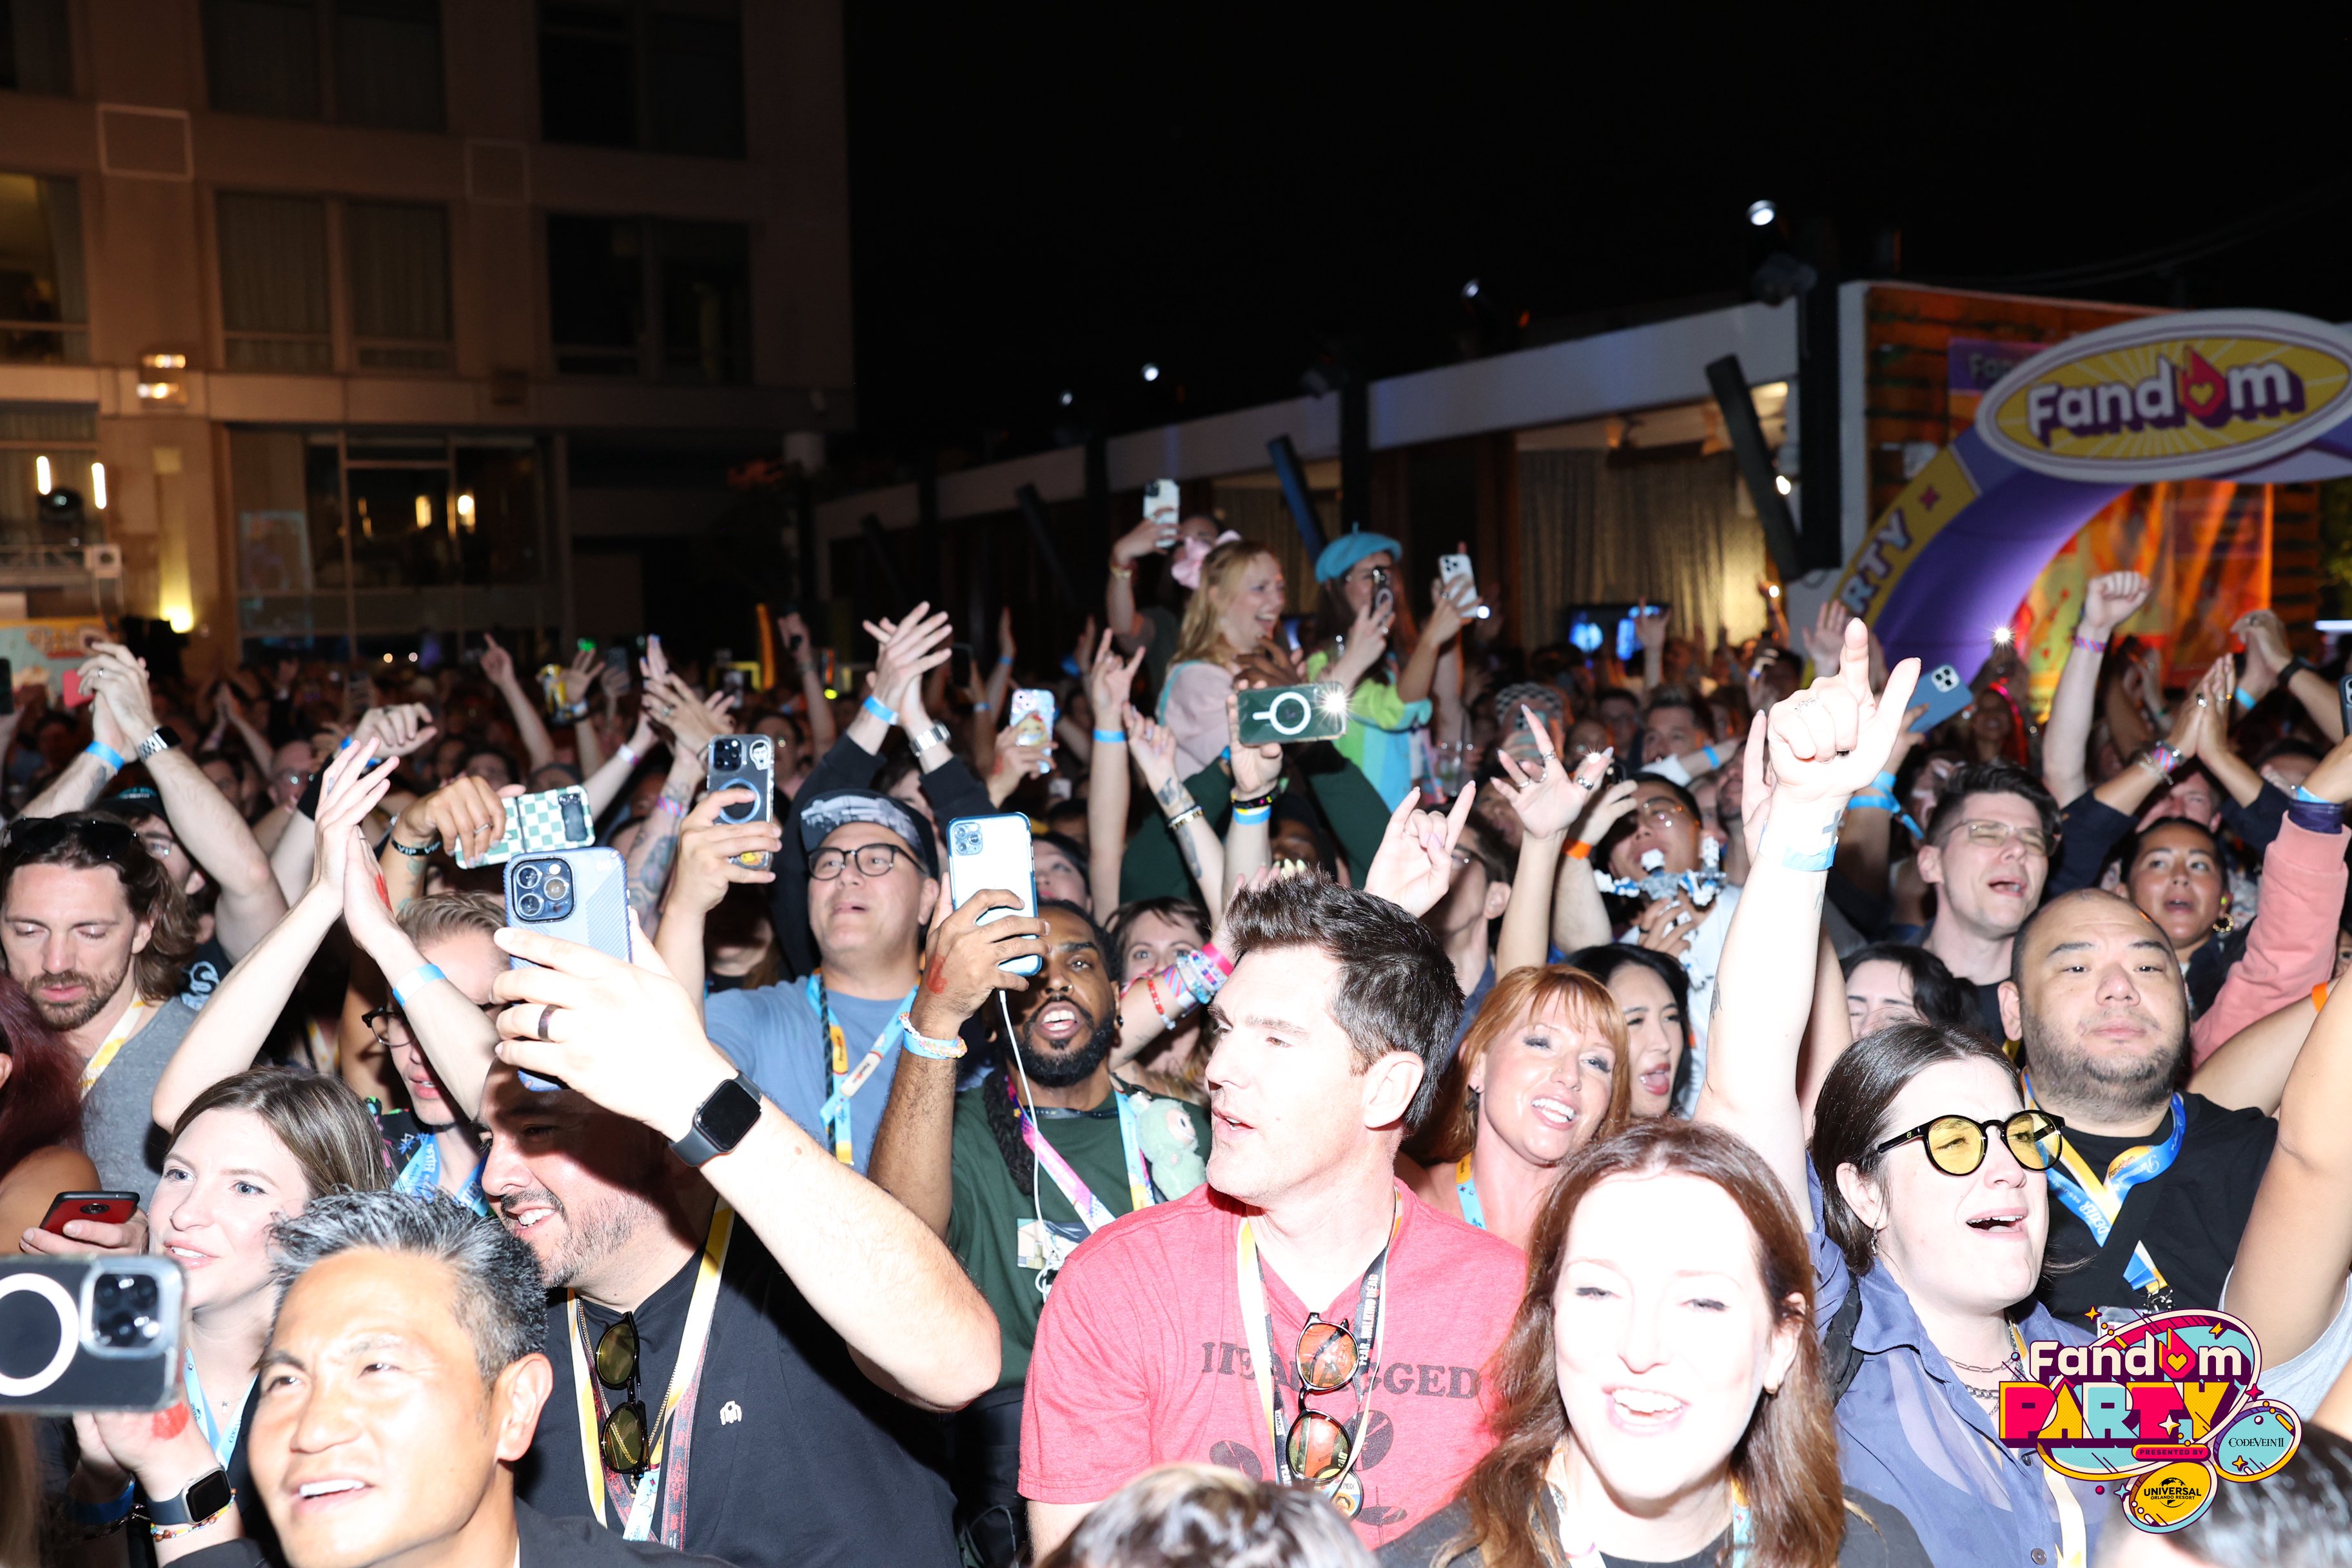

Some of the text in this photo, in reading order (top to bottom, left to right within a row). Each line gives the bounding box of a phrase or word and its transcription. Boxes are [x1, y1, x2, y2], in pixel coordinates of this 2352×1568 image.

[2027, 344, 2303, 447] Fandom
[397, 844, 417, 856] VIP
[2079, 1200, 2111, 1235] DEXTER
[1366, 1273, 1378, 1298] DEAD
[1360, 1298, 1377, 1339] WALKING
[1358, 1342, 1371, 1366] FEAR
